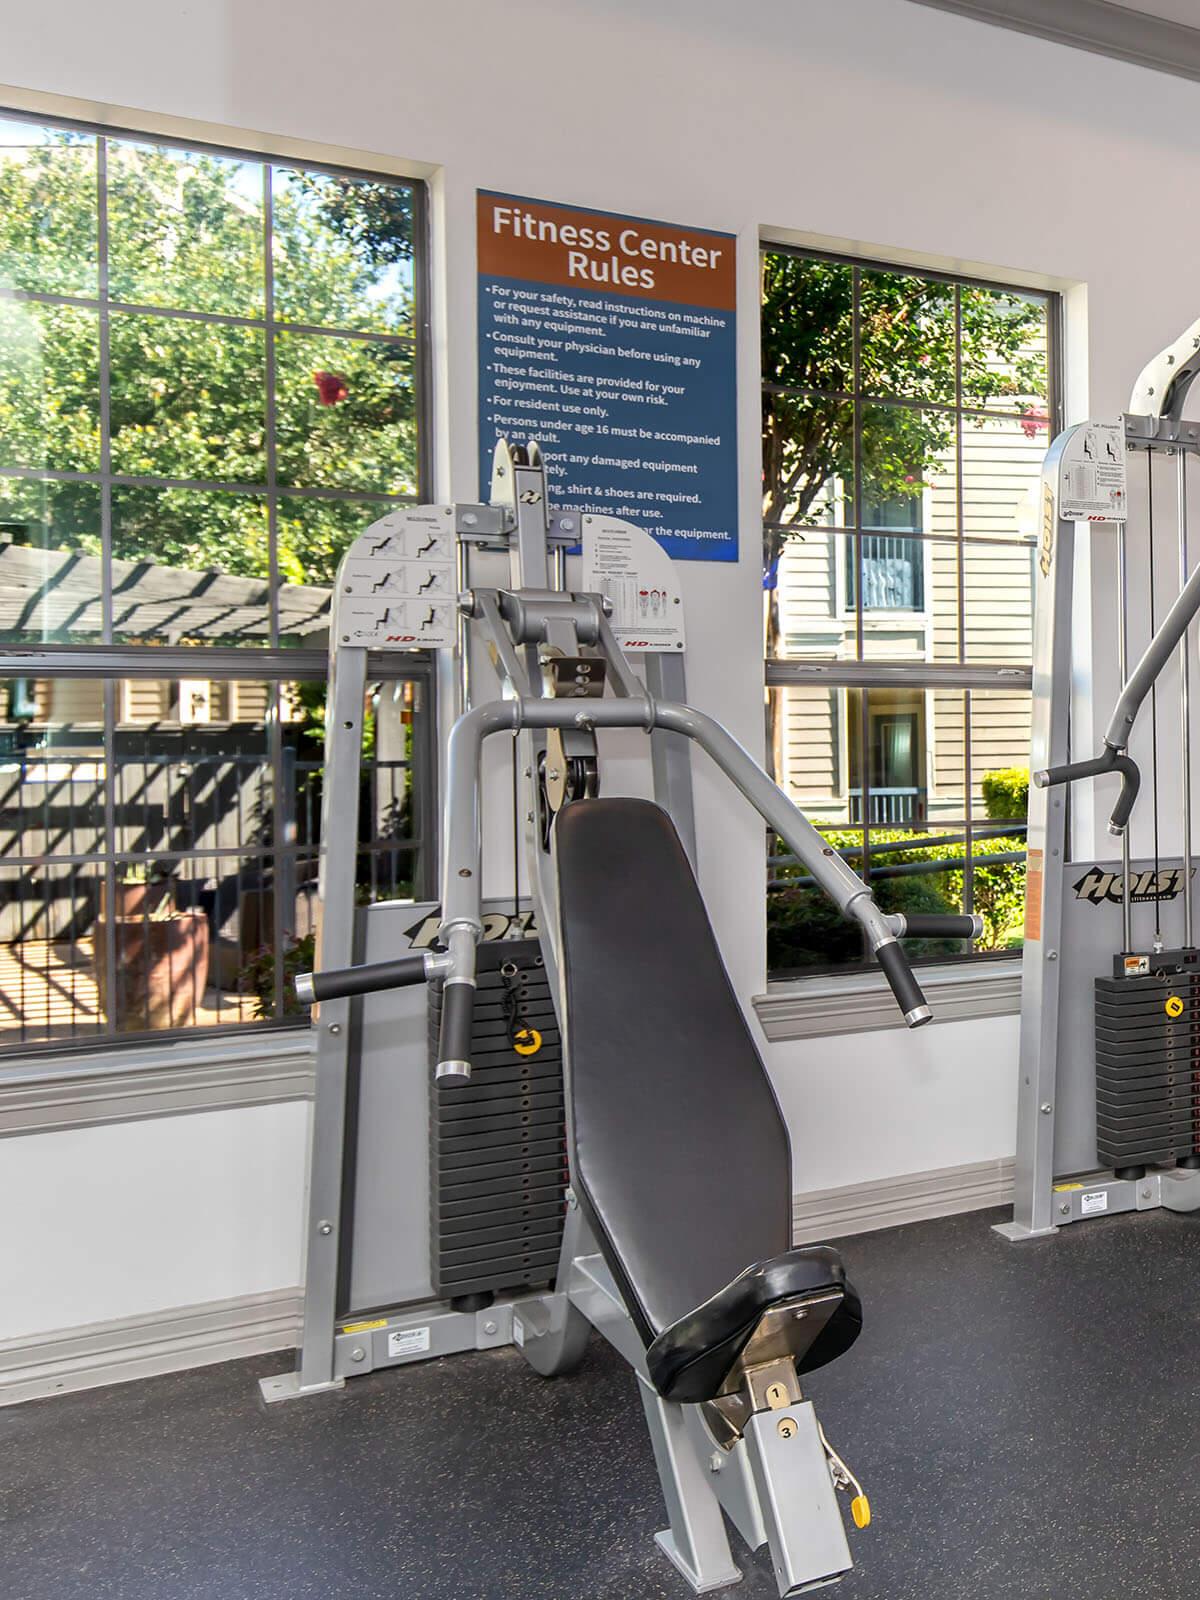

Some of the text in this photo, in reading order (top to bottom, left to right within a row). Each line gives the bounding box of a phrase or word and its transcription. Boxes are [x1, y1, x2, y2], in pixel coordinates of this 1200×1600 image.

[493, 206, 721, 270] Fitness Center
[568, 251, 655, 289] Rules
[492, 285, 726, 328] For your safety, read instructions on machine
[493, 300, 711, 338] or request assistance if you are unfamiliar
[493, 313, 606, 337] with any equipment.
[492, 331, 701, 369] Consult your physician before using any
[494, 347, 558, 362] equipment.
[493, 363, 685, 395] These facilities are provided for your
[494, 378, 668, 406] enjoyment. Use at your own risk.
[493, 395, 609, 418] For resident use only.
[493, 414, 720, 445] Persons under age 16 must be accompanied
[495, 427, 560, 443] by an adult.
[569, 455, 589, 466] any
[591, 456, 640, 469] damaged
[642, 461, 698, 473] equipment
[567, 484, 592, 495] shirt
[594, 486, 602, 496] &
[605, 487, 635, 498] shoes
[637, 490, 654, 500] are
[655, 492, 702, 504] required.
[562, 503, 614, 514] machines
[616, 506, 640, 516] after
[642, 510, 664, 518] use.
[655, 526, 673, 536] the
[674, 527, 731, 540] equipment.
[772, 1388, 780, 1398] 1
[782, 1428, 791, 1439] 3
